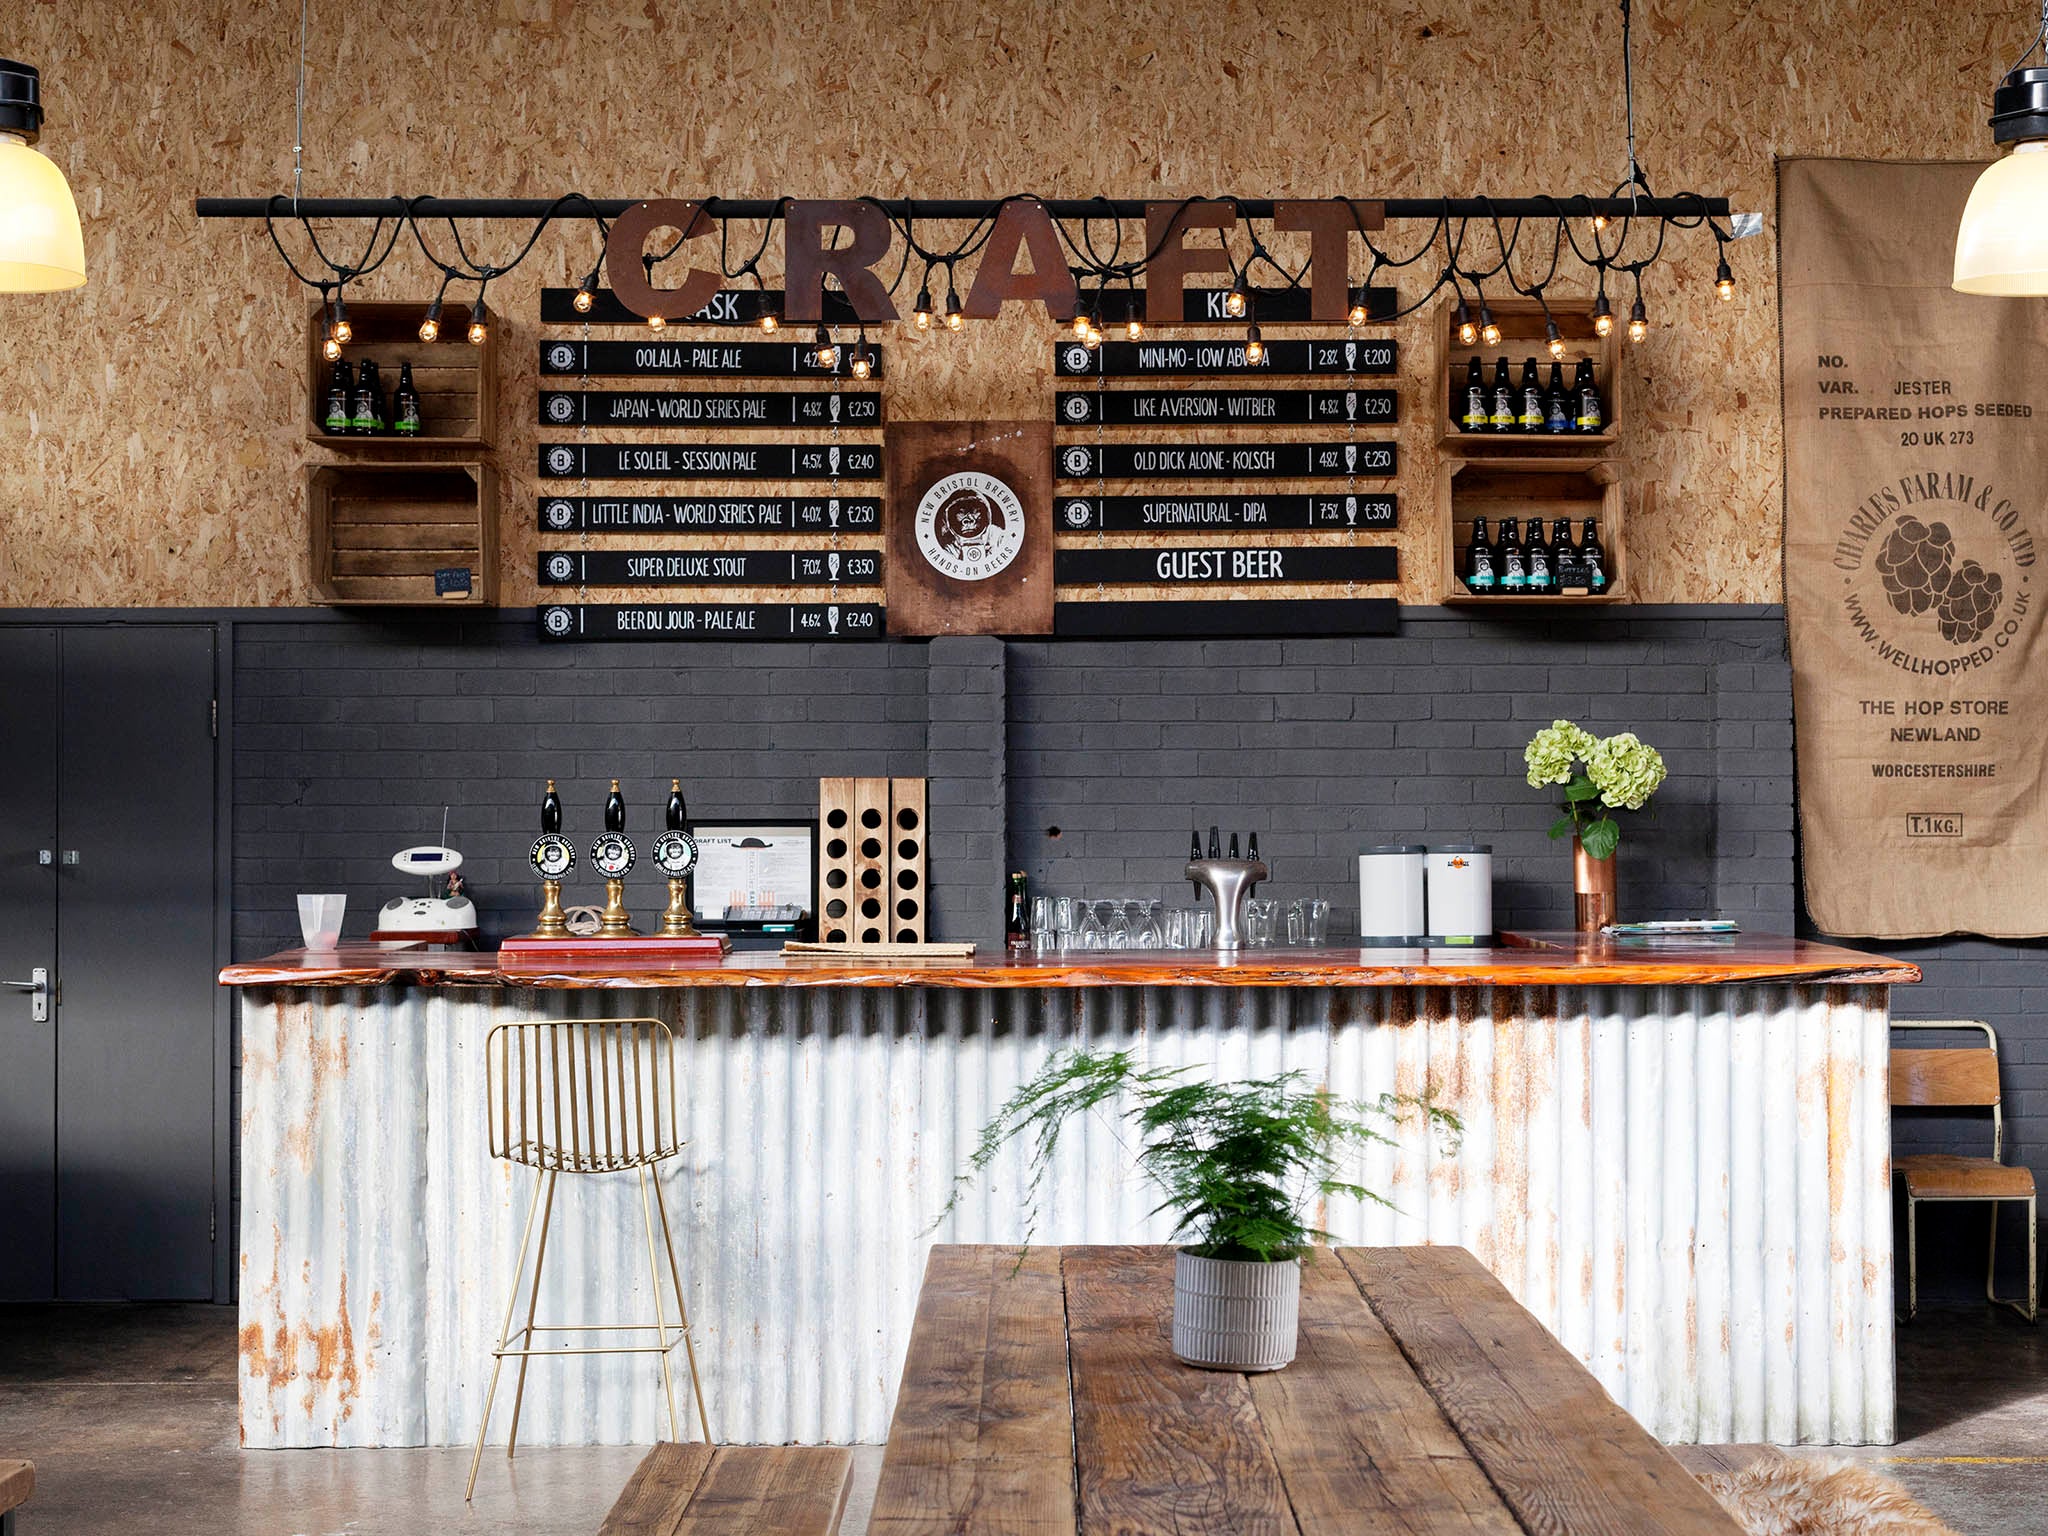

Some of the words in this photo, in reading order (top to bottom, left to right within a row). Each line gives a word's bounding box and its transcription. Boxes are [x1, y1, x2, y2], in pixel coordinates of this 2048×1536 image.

[606, 199, 1386, 321] CRAFT
[686, 294, 739, 320] ASK
[636, 349, 681, 367] OOLALA
[693, 349, 718, 368] PALE
[722, 350, 741, 368] ALE
[1140, 348, 1186, 368] MINI-MO
[1197, 348, 1224, 367] LOW
[1818, 355, 1848, 368] NO.
[1819, 381, 1859, 394] VAR.
[1894, 381, 1951, 394] JESTER
[610, 399, 648, 417] JAPAN
[657, 399, 701, 418] WORLD
[706, 400, 740, 418] SERIES
[743, 400, 766, 418] PALE
[803, 402, 821, 416] 4.8%
[1134, 398, 1156, 416] LIKE
[1228, 398, 1275, 416] WITBIER
[1320, 400, 1338, 414] 4.8%
[1819, 407, 1912, 420] PREPARED
[1918, 405, 1967, 419] HOPS
[1974, 404, 2032, 418] SEEDED
[1901, 432, 1919, 446] 20
[1924, 432, 1945, 446] UK
[1950, 431, 1974, 444] 273
[619, 451, 630, 470] LE
[634, 451, 671, 470] SOLEIL
[683, 451, 730, 470] SESSION
[733, 452, 756, 470] PALE
[802, 454, 821, 468] 4.5%
[1134, 452, 1156, 470] OLD
[1160, 452, 1185, 469] DICK
[1189, 451, 1224, 469] ALONE
[1233, 451, 1274, 469] KOLSCH
[921, 502, 934, 523] NEW
[934, 478, 978, 499] BRISTOL
[985, 481, 1019, 523] BREWERY
[593, 504, 629, 523] LITTLE
[633, 504, 663, 523] INDIA
[674, 504, 716, 523] WORLD
[719, 504, 755, 523] SERIES
[759, 504, 782, 523] PALE
[802, 506, 821, 522] 4.0%
[1143, 503, 1232, 523] SUPERNATURAL
[1244, 503, 1266, 522] DIPA
[1320, 503, 1338, 519] 7.5%
[1833, 486, 1901, 570] CHARLES
[1899, 472, 1974, 505] FARAM
[1974, 485, 1993, 512] &
[1991, 499, 2019, 531] CO
[628, 558, 664, 576] SUPER
[667, 558, 709, 576] DELUXE
[713, 558, 746, 576] STOUT
[802, 559, 821, 574] 7.0%
[985, 547, 1013, 572] BEERS
[1157, 551, 1226, 578] GUEST
[1233, 551, 1283, 578] BEER
[618, 611, 645, 629] BEER
[647, 611, 662, 629] DU
[665, 611, 694, 629] JOUR
[705, 611, 733, 629] PALE
[735, 611, 755, 629] ALE
[801, 614, 820, 627] 4.6%
[1844, 591, 2031, 676] WWW.WELLHOPPED.CO.UK
[1859, 701, 1895, 715] THE
[1905, 701, 1944, 715] HOP
[1950, 701, 2008, 715] STORE
[1890, 728, 1981, 742] NEWLAND
[1872, 764, 1995, 777] WORCESTERSHIRE
[1910, 816, 1958, 833] T.1KG.
